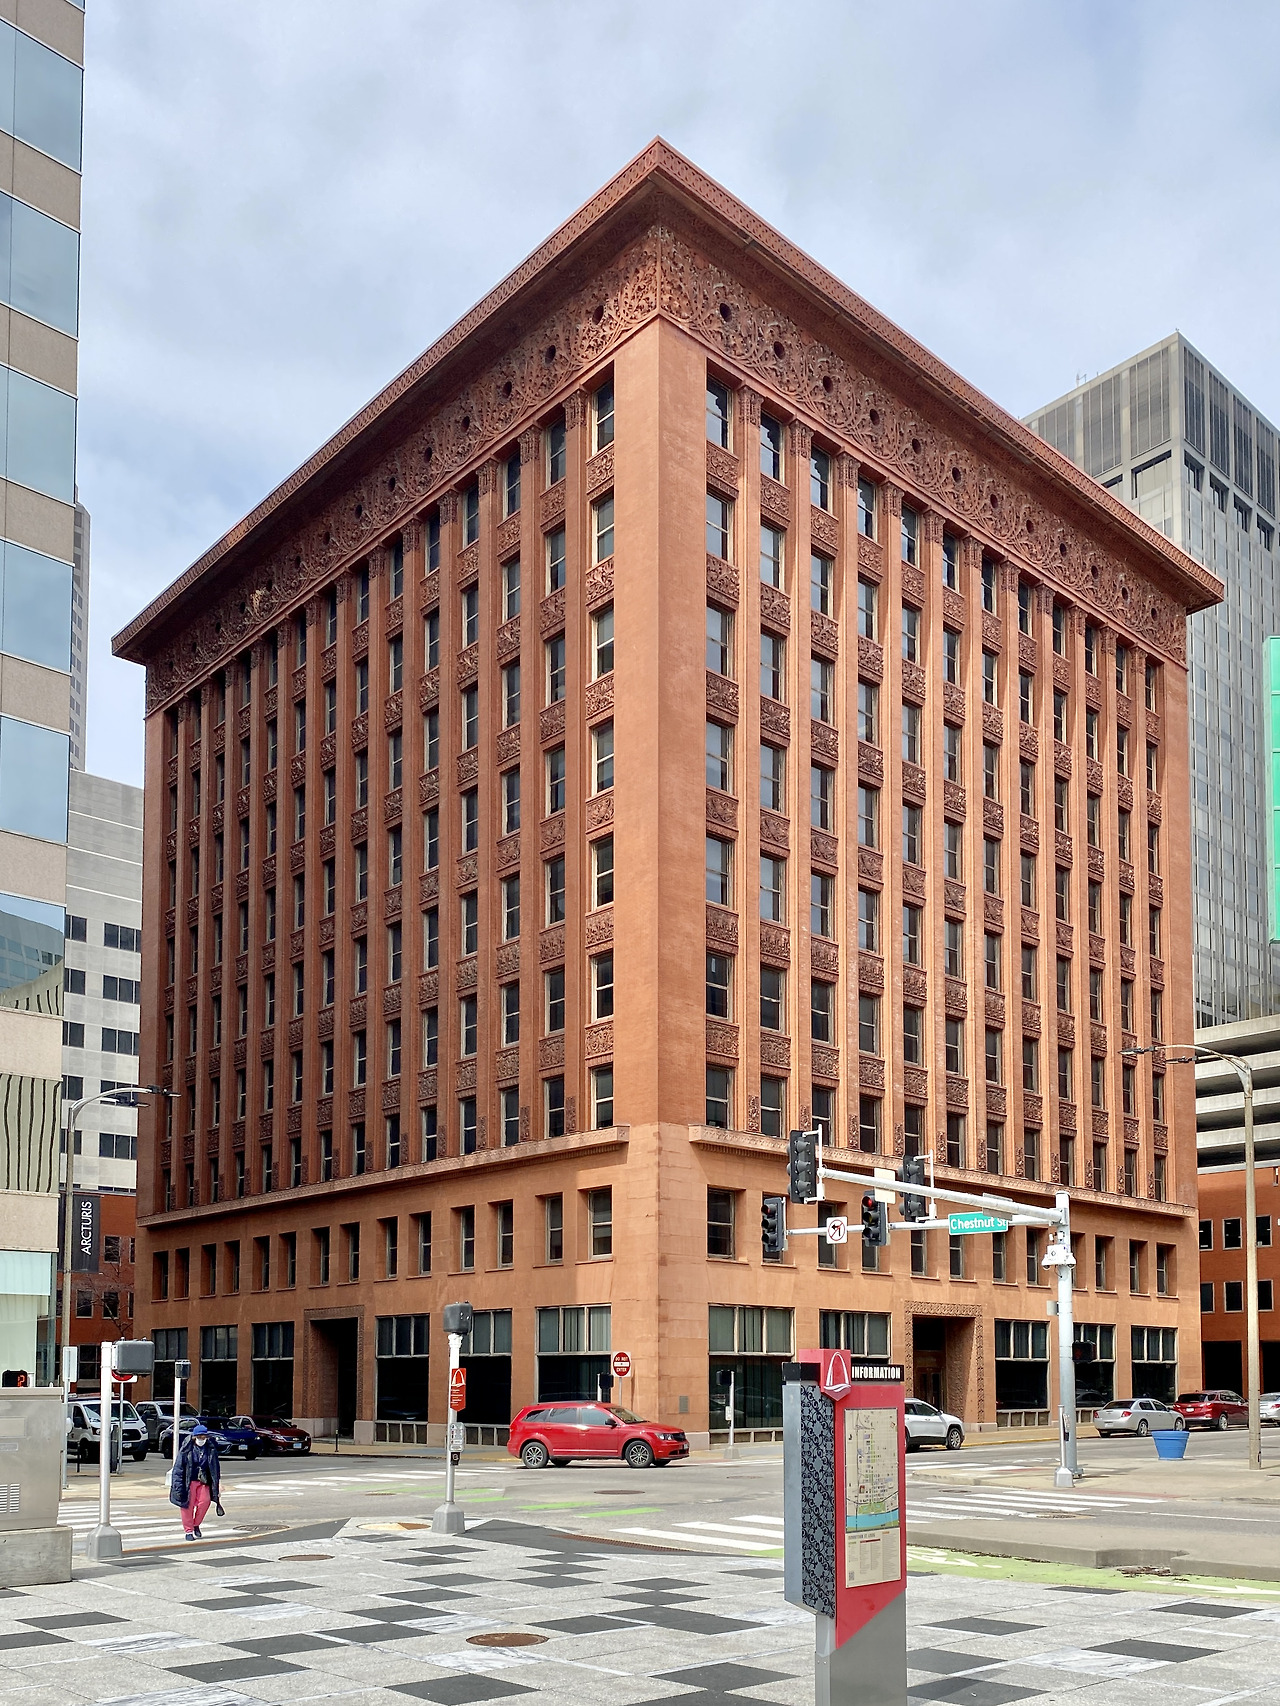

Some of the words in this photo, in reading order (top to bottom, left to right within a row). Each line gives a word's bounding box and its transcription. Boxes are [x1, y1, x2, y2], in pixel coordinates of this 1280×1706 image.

[81, 1201, 92, 1255] ARCTURIS
[951, 1217, 994, 1230] Chestnut
[851, 1366, 901, 1379] INFORMATION
